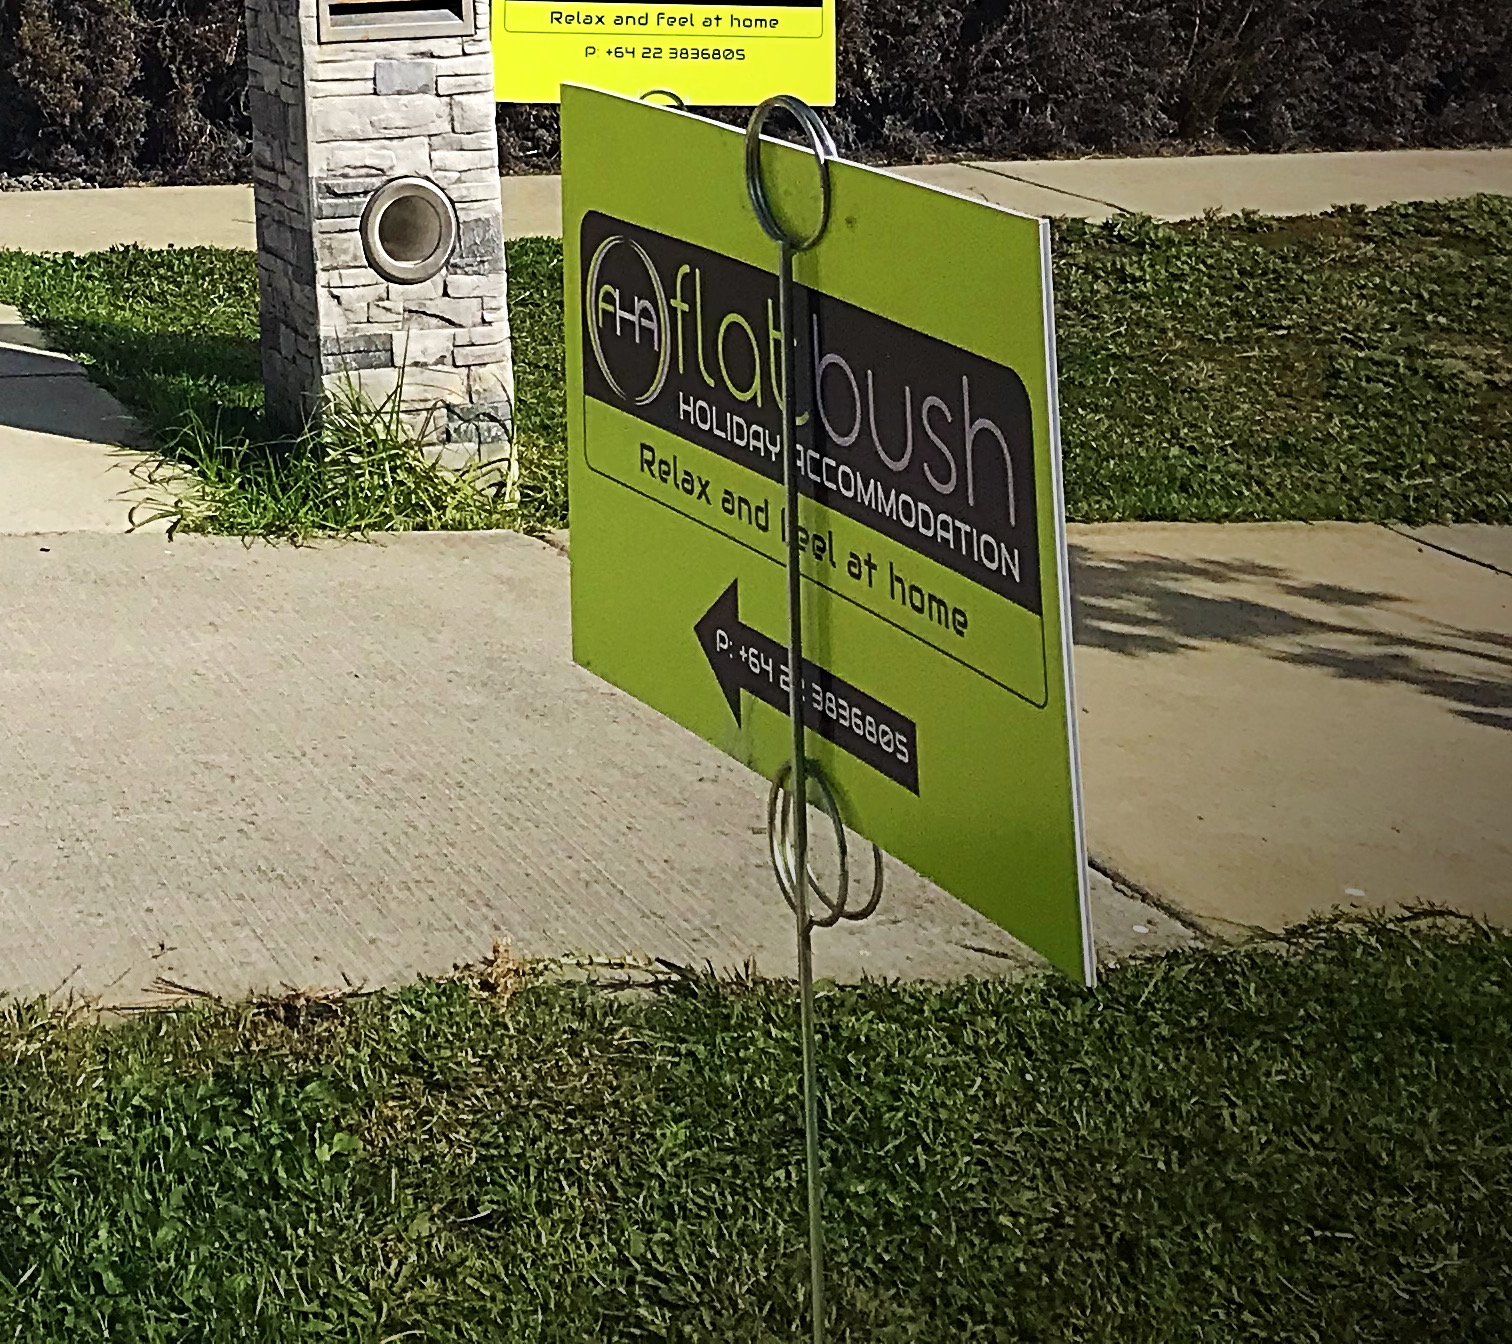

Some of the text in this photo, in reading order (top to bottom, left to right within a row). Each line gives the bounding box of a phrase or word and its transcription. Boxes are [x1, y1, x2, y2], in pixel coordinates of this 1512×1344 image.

[550, 11, 779, 29] Relax and feel at home
[605, 46, 636, 59] +64
[641, 47, 663, 59] 22
[668, 48, 746, 60] 3836805
[670, 262, 1016, 528] flatbush
[639, 442, 713, 506] Relax
[721, 487, 769, 533] and
[847, 549, 878, 588] at
[889, 563, 970, 638] home
[679, 391, 1021, 584] HOLIDAY ACCOMMODATION
[739, 645, 774, 683] +64
[812, 682, 909, 764] 3836805
